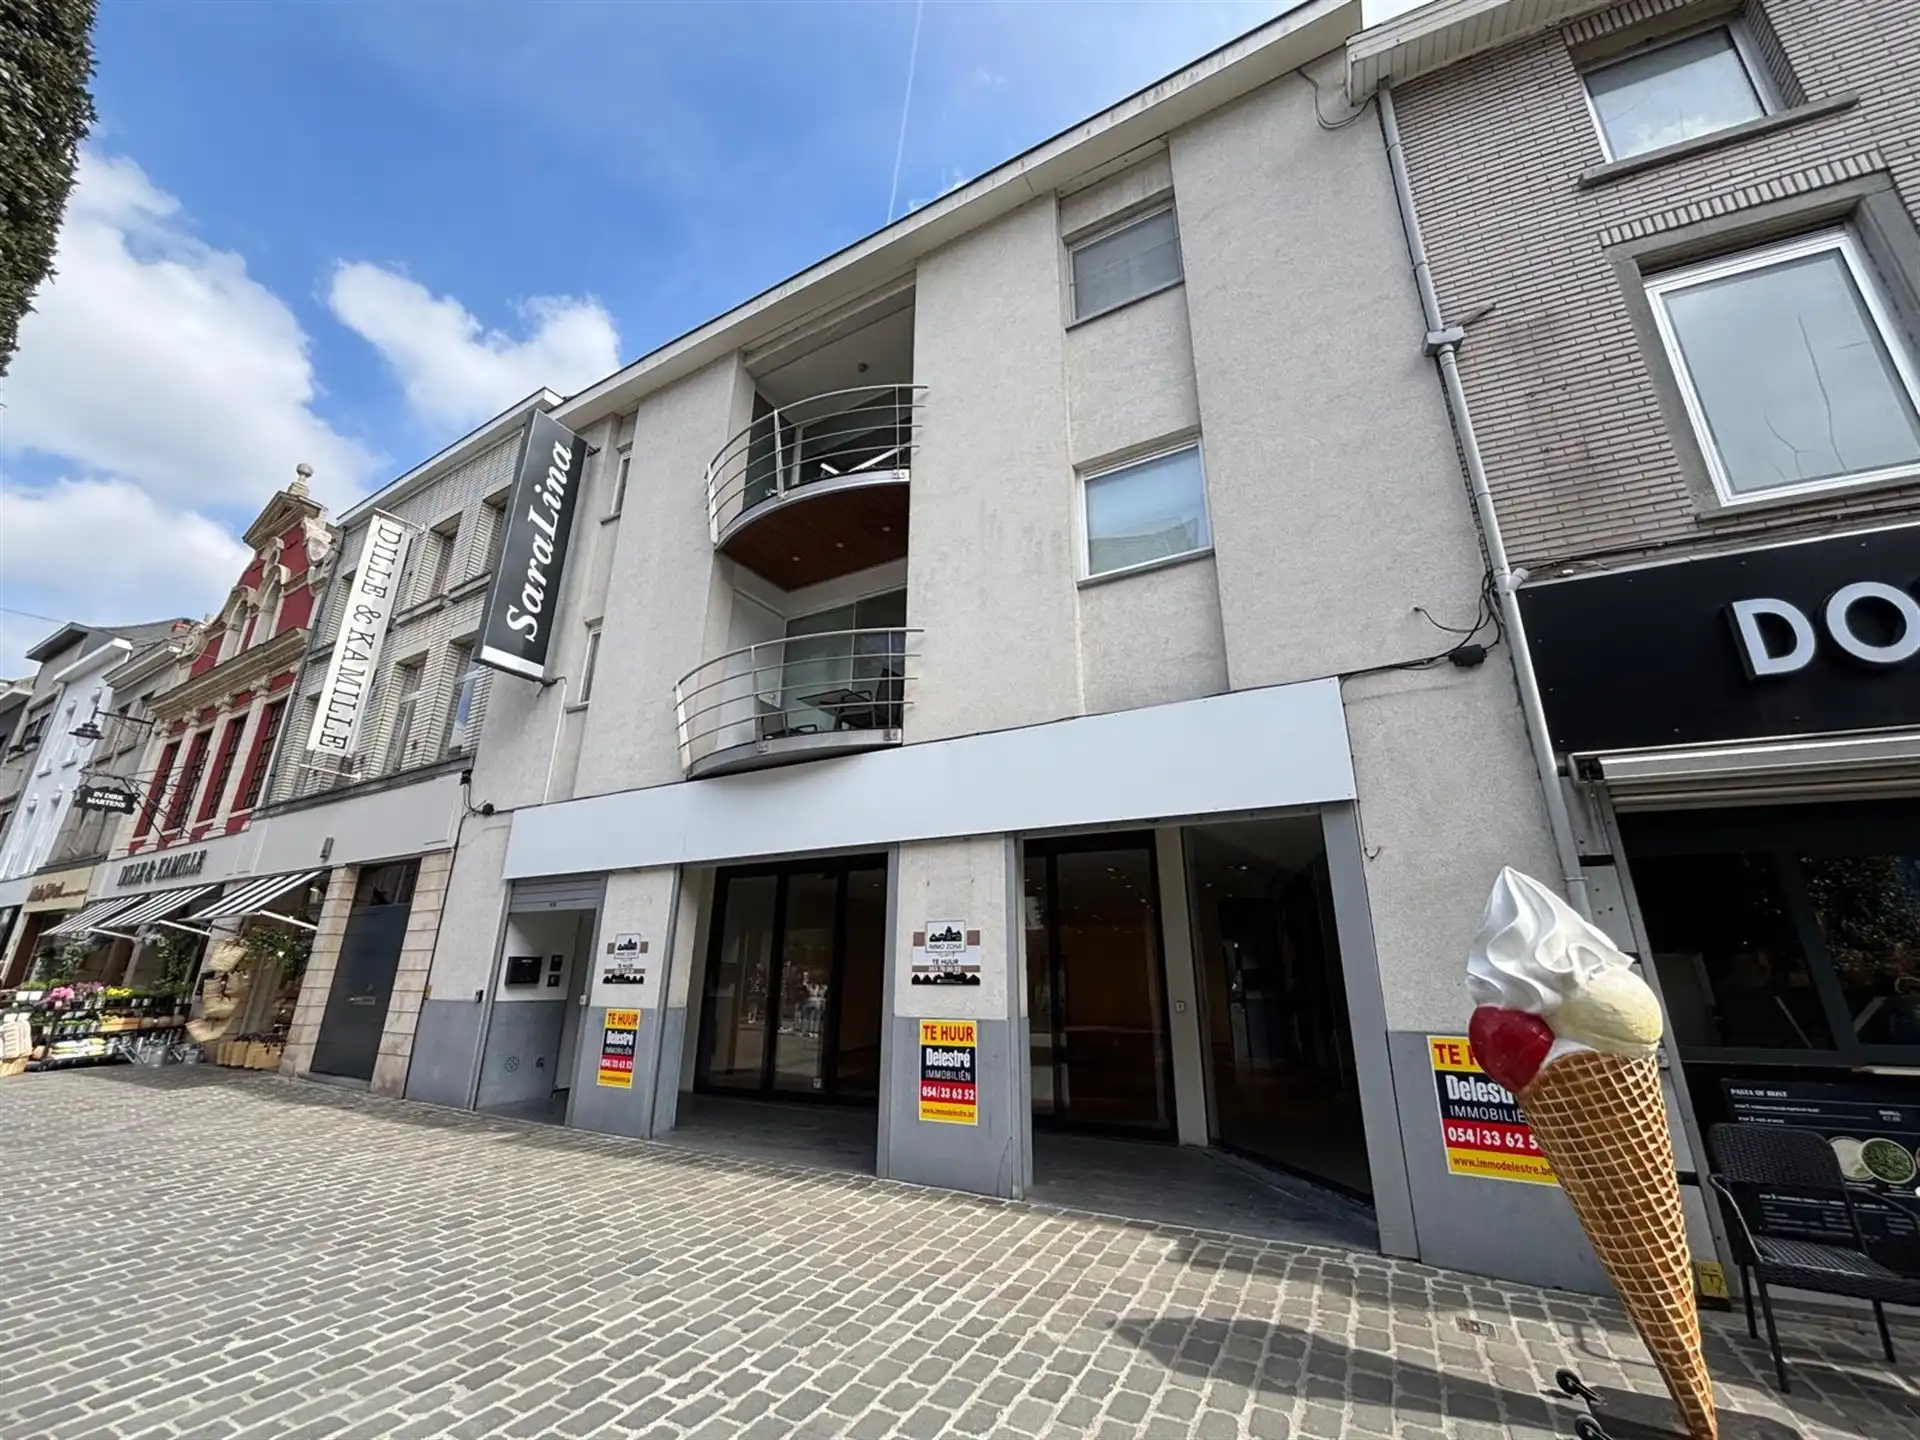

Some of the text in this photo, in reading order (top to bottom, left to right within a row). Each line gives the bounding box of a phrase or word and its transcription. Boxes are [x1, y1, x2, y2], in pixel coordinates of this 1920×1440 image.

[506, 440, 573, 643] SaraLina
[319, 523, 403, 751] DILLE & KAMILLE
[86, 797, 126, 808] MARTENS
[607, 1012, 639, 1027] TE HUUR
[923, 1024, 974, 1043] TE HUUR
[926, 1047, 970, 1069] Delestré
[1434, 1043, 1462, 1065] TE
[952, 1087, 962, 1100] 62
[964, 1088, 975, 1101] 52
[1505, 1132, 1525, 1149] 62
[1529, 1134, 1539, 1150] 5
